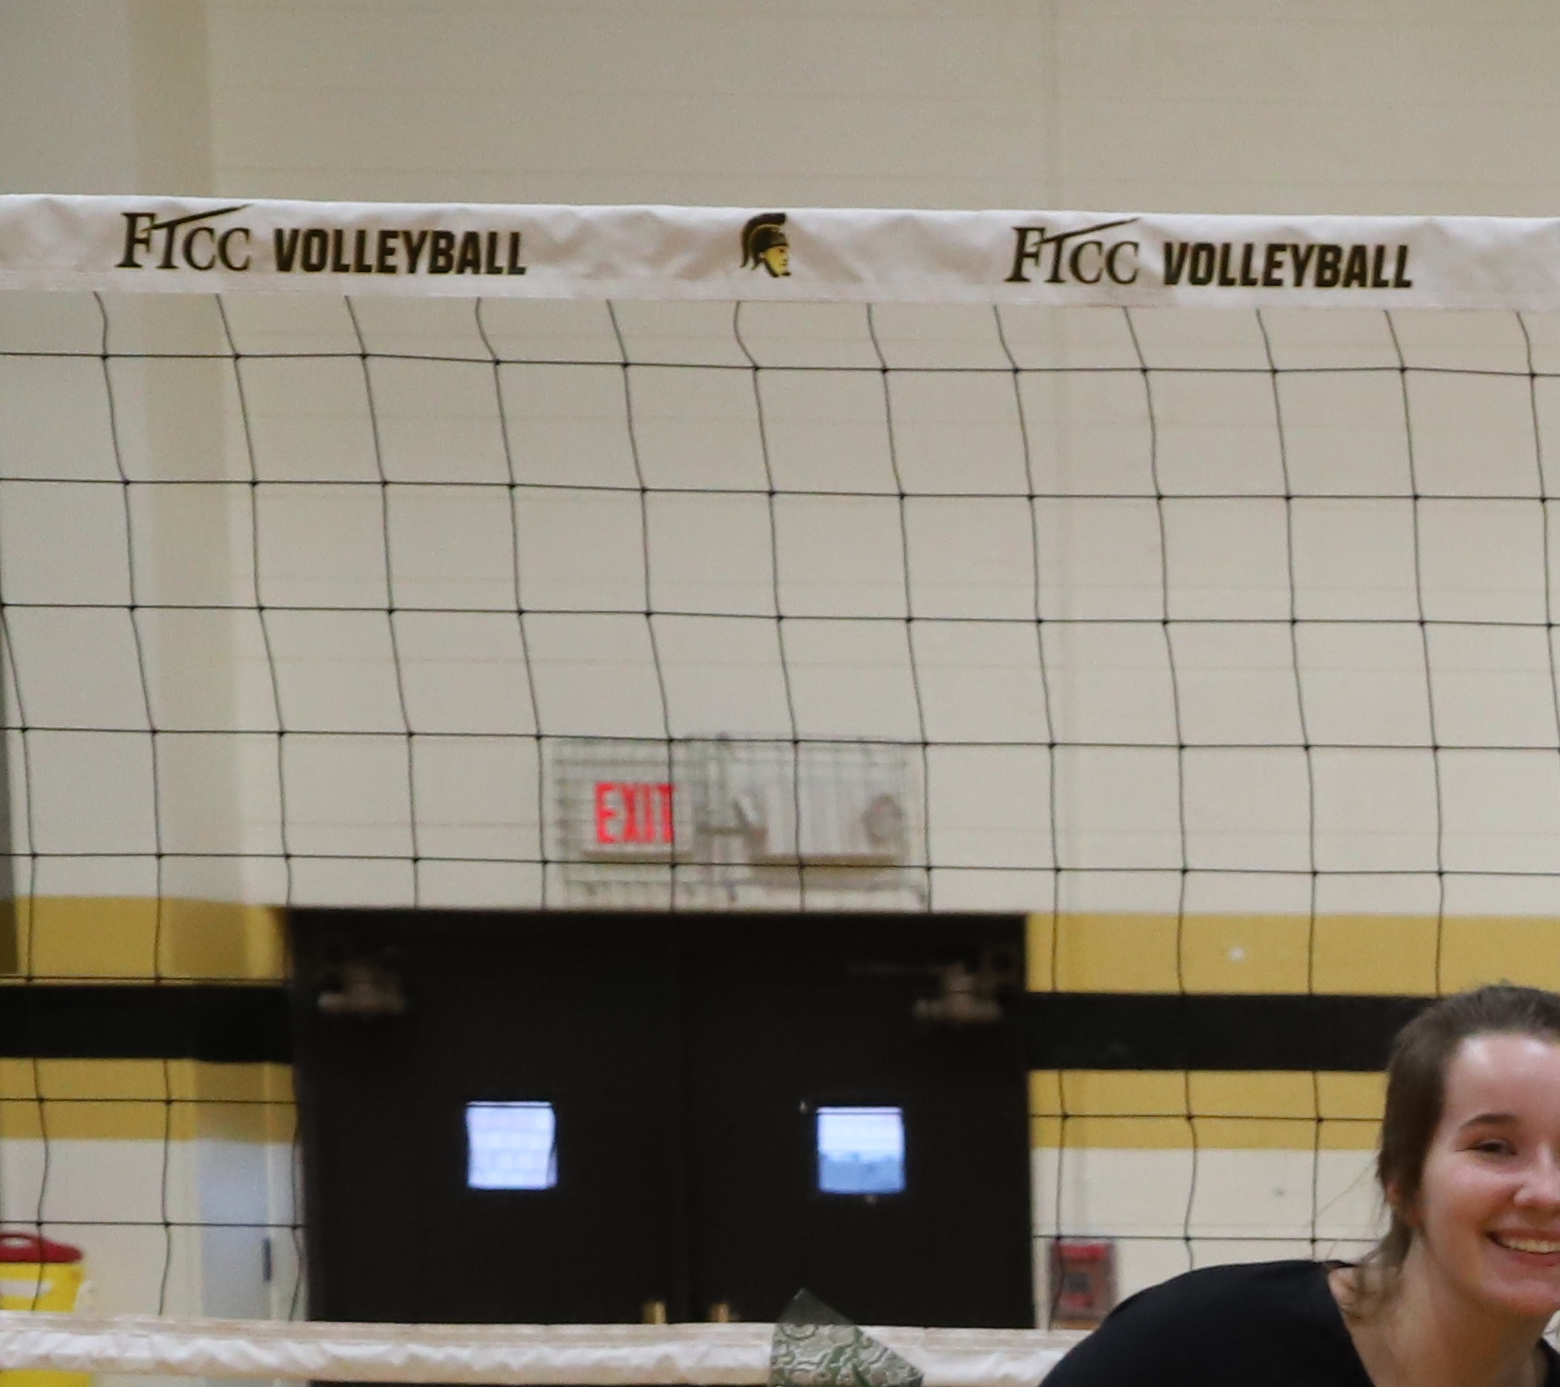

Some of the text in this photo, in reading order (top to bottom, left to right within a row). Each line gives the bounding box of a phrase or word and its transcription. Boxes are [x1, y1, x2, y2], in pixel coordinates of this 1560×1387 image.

[116, 207, 527, 276] FTCC VOLLEYBALL
[1005, 221, 1412, 289] FTCC VOLLEYBALL
[595, 782, 675, 844] EXIT
